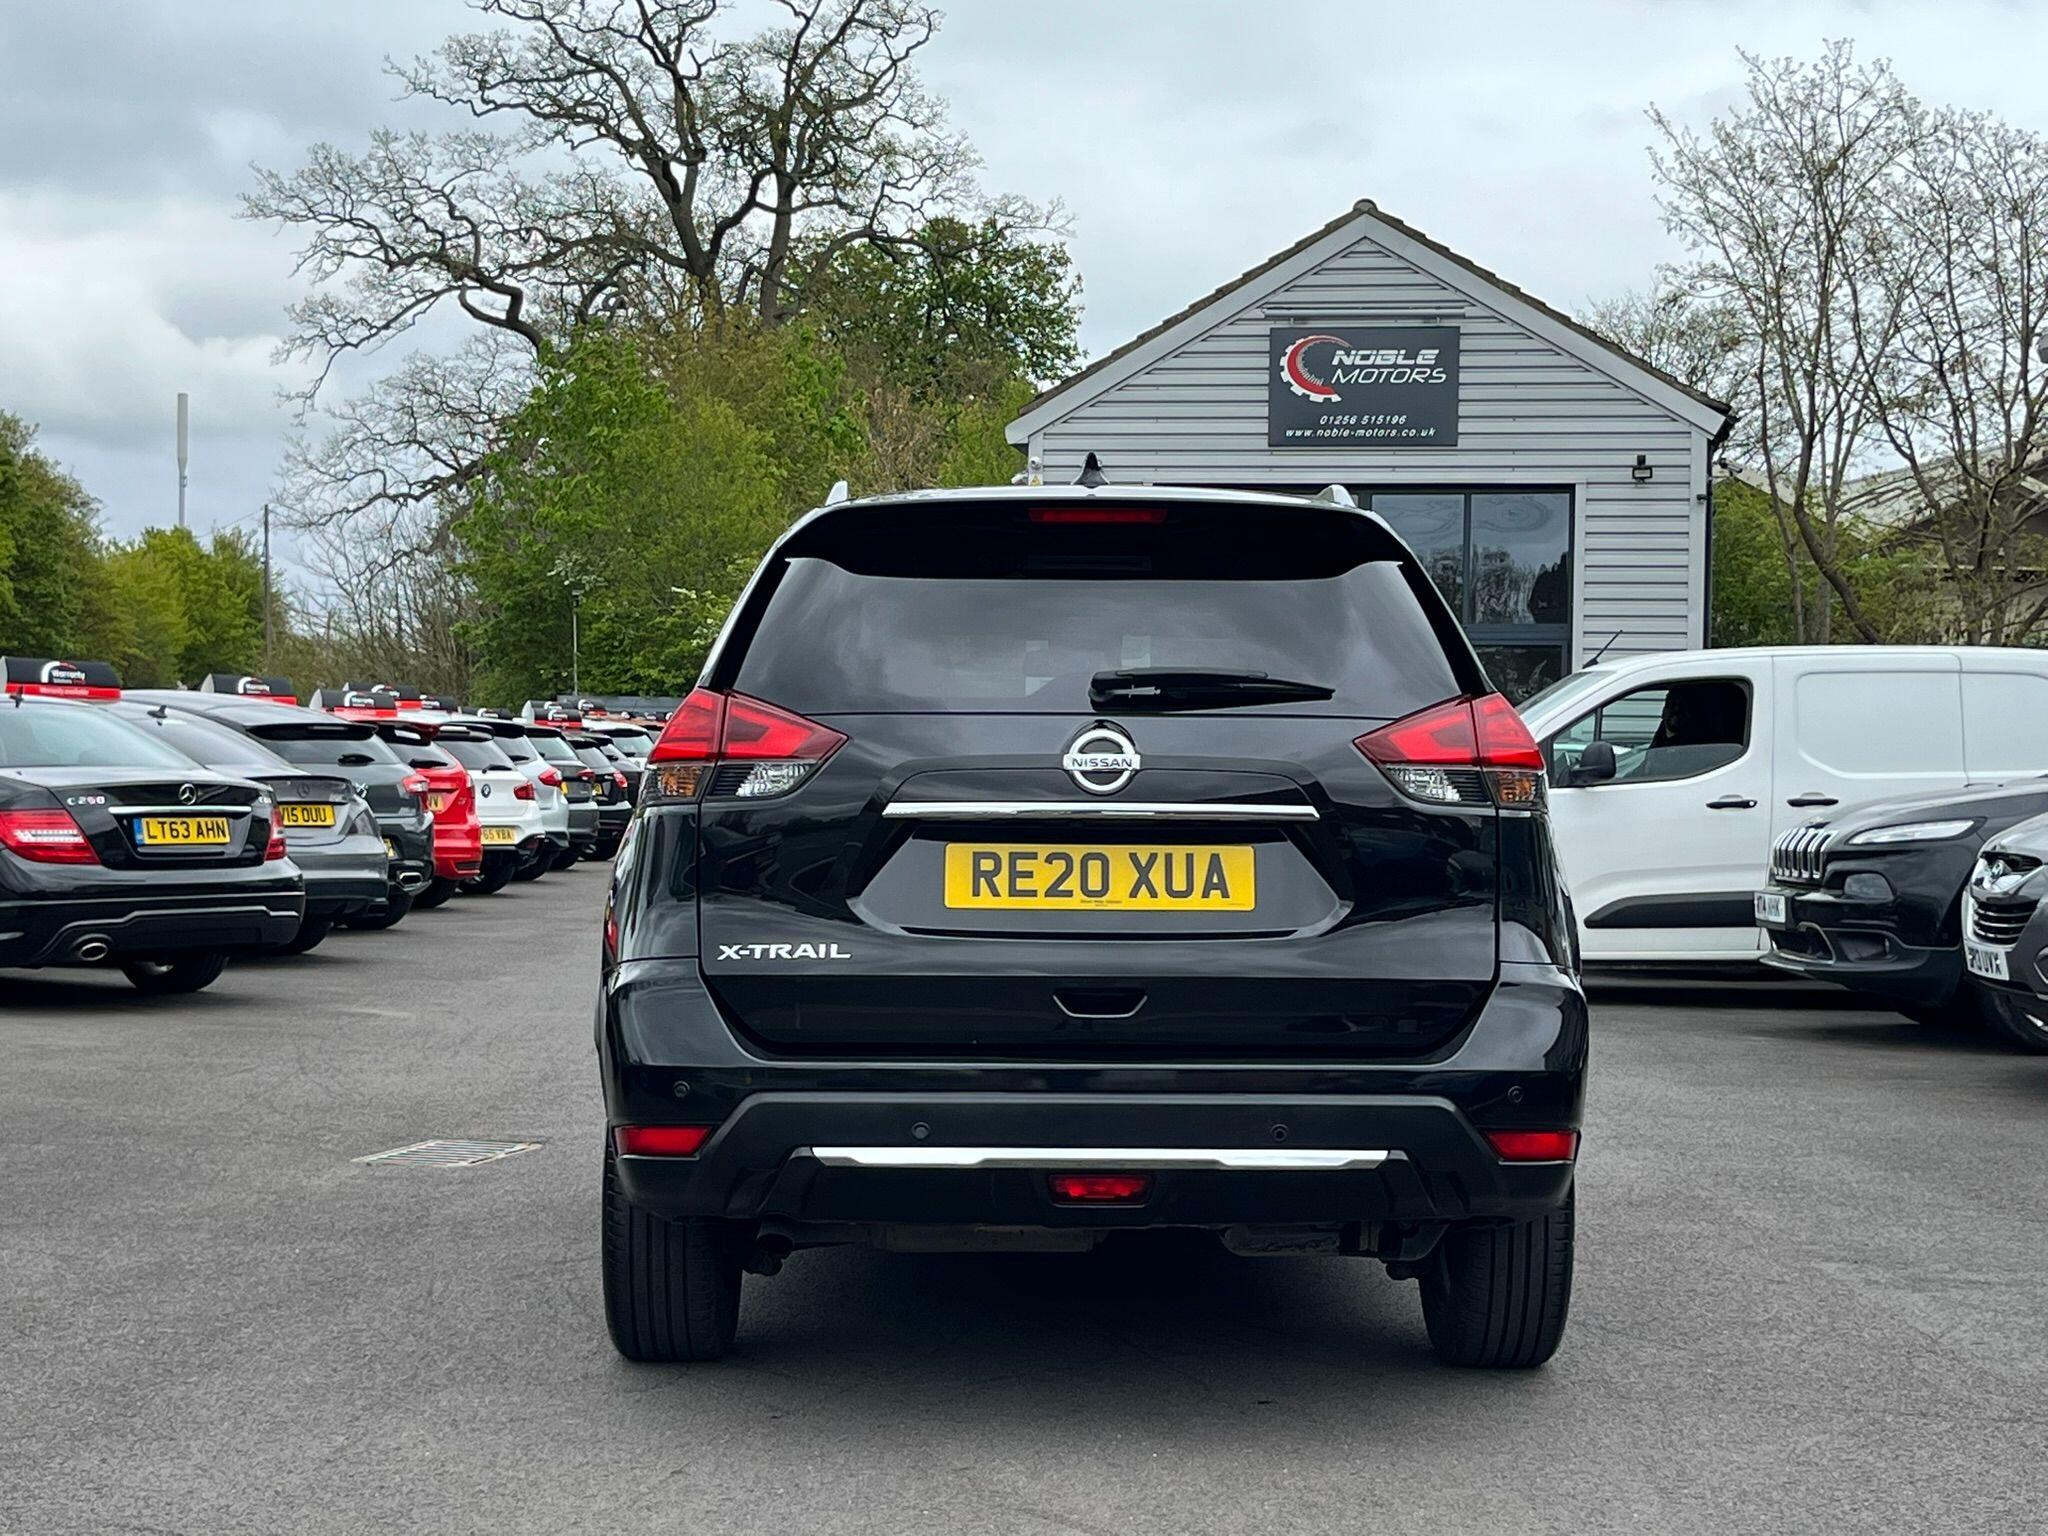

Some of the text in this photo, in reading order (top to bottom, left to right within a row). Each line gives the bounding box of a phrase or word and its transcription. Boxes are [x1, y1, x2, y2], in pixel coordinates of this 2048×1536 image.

[1331, 349, 1440, 366] NOBLE
[1331, 367, 1447, 384] MOTORS
[1285, 427, 1437, 438] www.noble-motors.co.uk
[1071, 757, 1133, 768] NISSAN
[146, 818, 227, 841] LT63 AHN
[970, 850, 1231, 899] RE20 XUA
[716, 943, 853, 961] X-TRAIL
